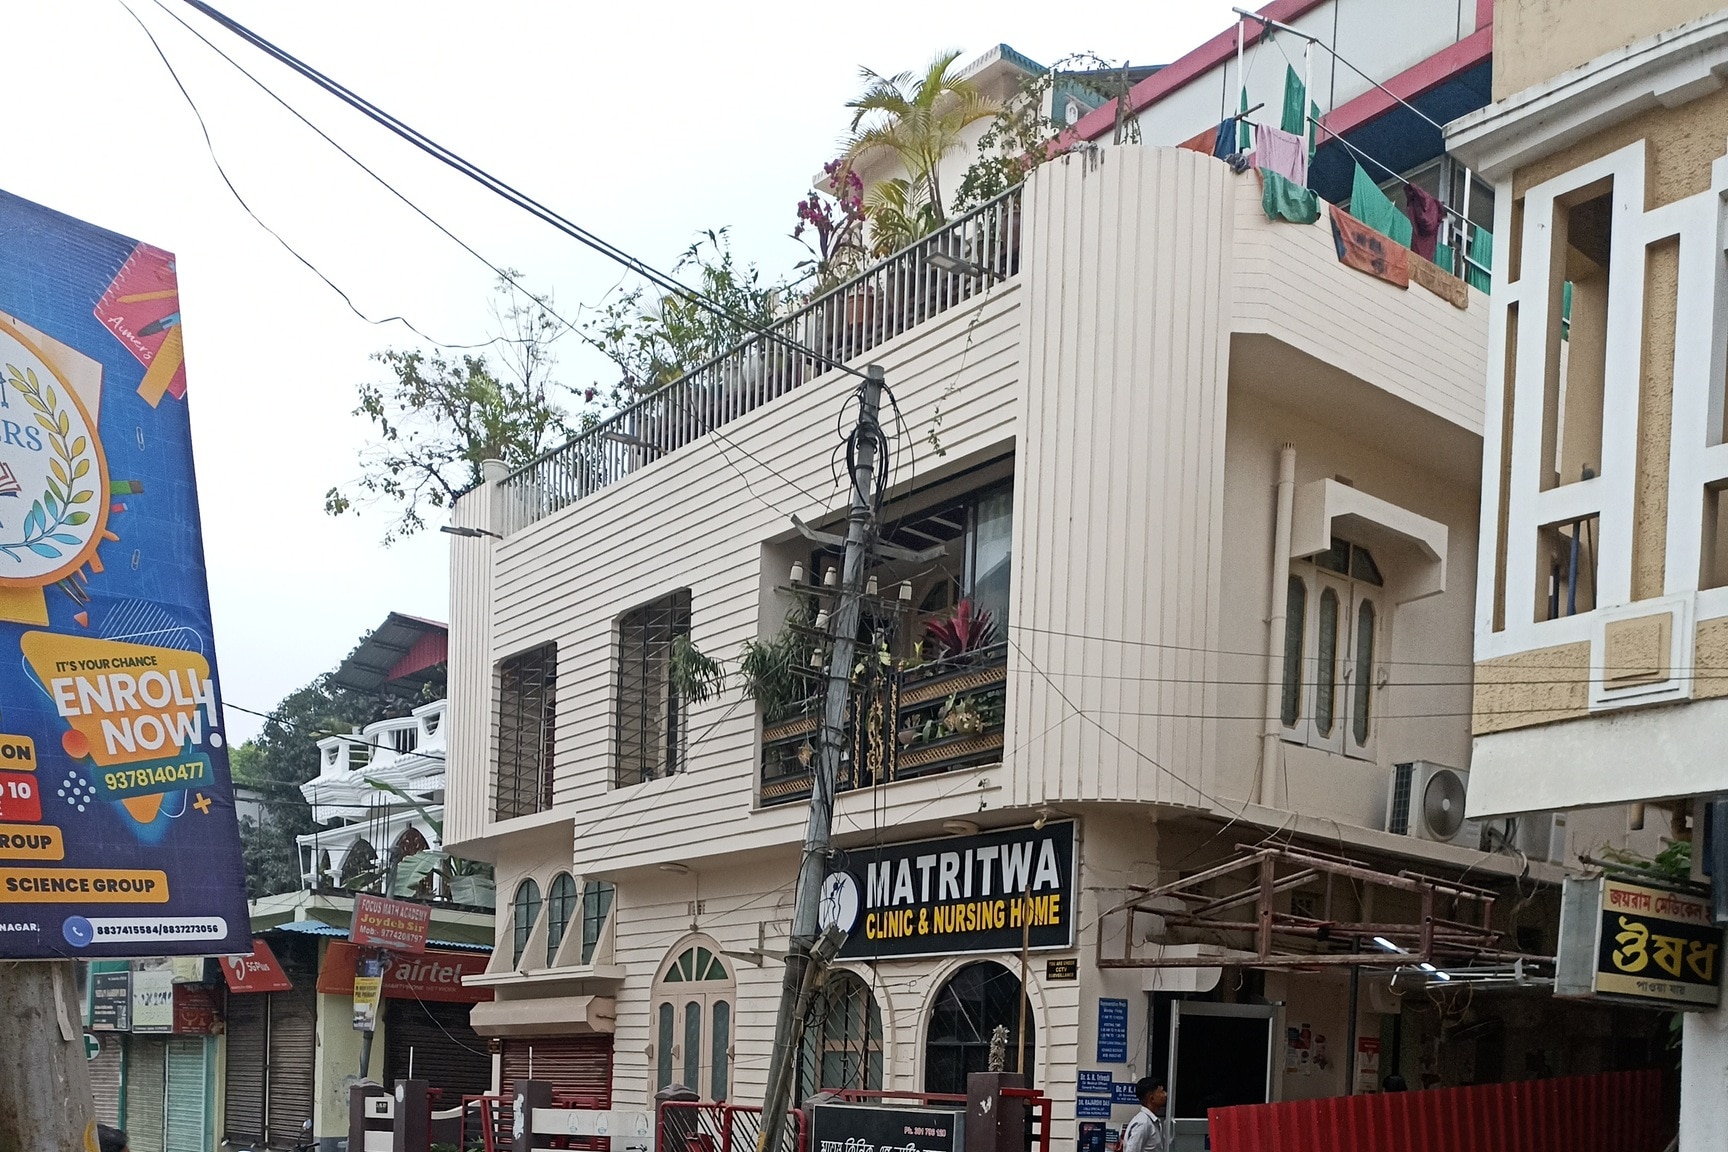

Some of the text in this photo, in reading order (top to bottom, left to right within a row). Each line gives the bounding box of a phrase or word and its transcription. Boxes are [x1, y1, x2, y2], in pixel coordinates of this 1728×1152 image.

[107, 315, 153, 361] Aimers
[55, 655, 157, 673] IT'S YOUR CHANCE
[104, 761, 204, 791] 9378140477
[8, 782, 31, 799] 10
[6, 877, 155, 893] SCIENCE GROUP
[866, 838, 1060, 909] MATRITWA
[361, 899, 428, 922] FOCUS MATH ACADEMY
[866, 894, 1060, 939] CLINIC & NURSING HOME
[97, 924, 218, 936] 8837415584/8837273056
[406, 922, 425, 932] Sir
[1612, 915, 1718, 981] ঔষধ
[395, 959, 462, 984] airtel
